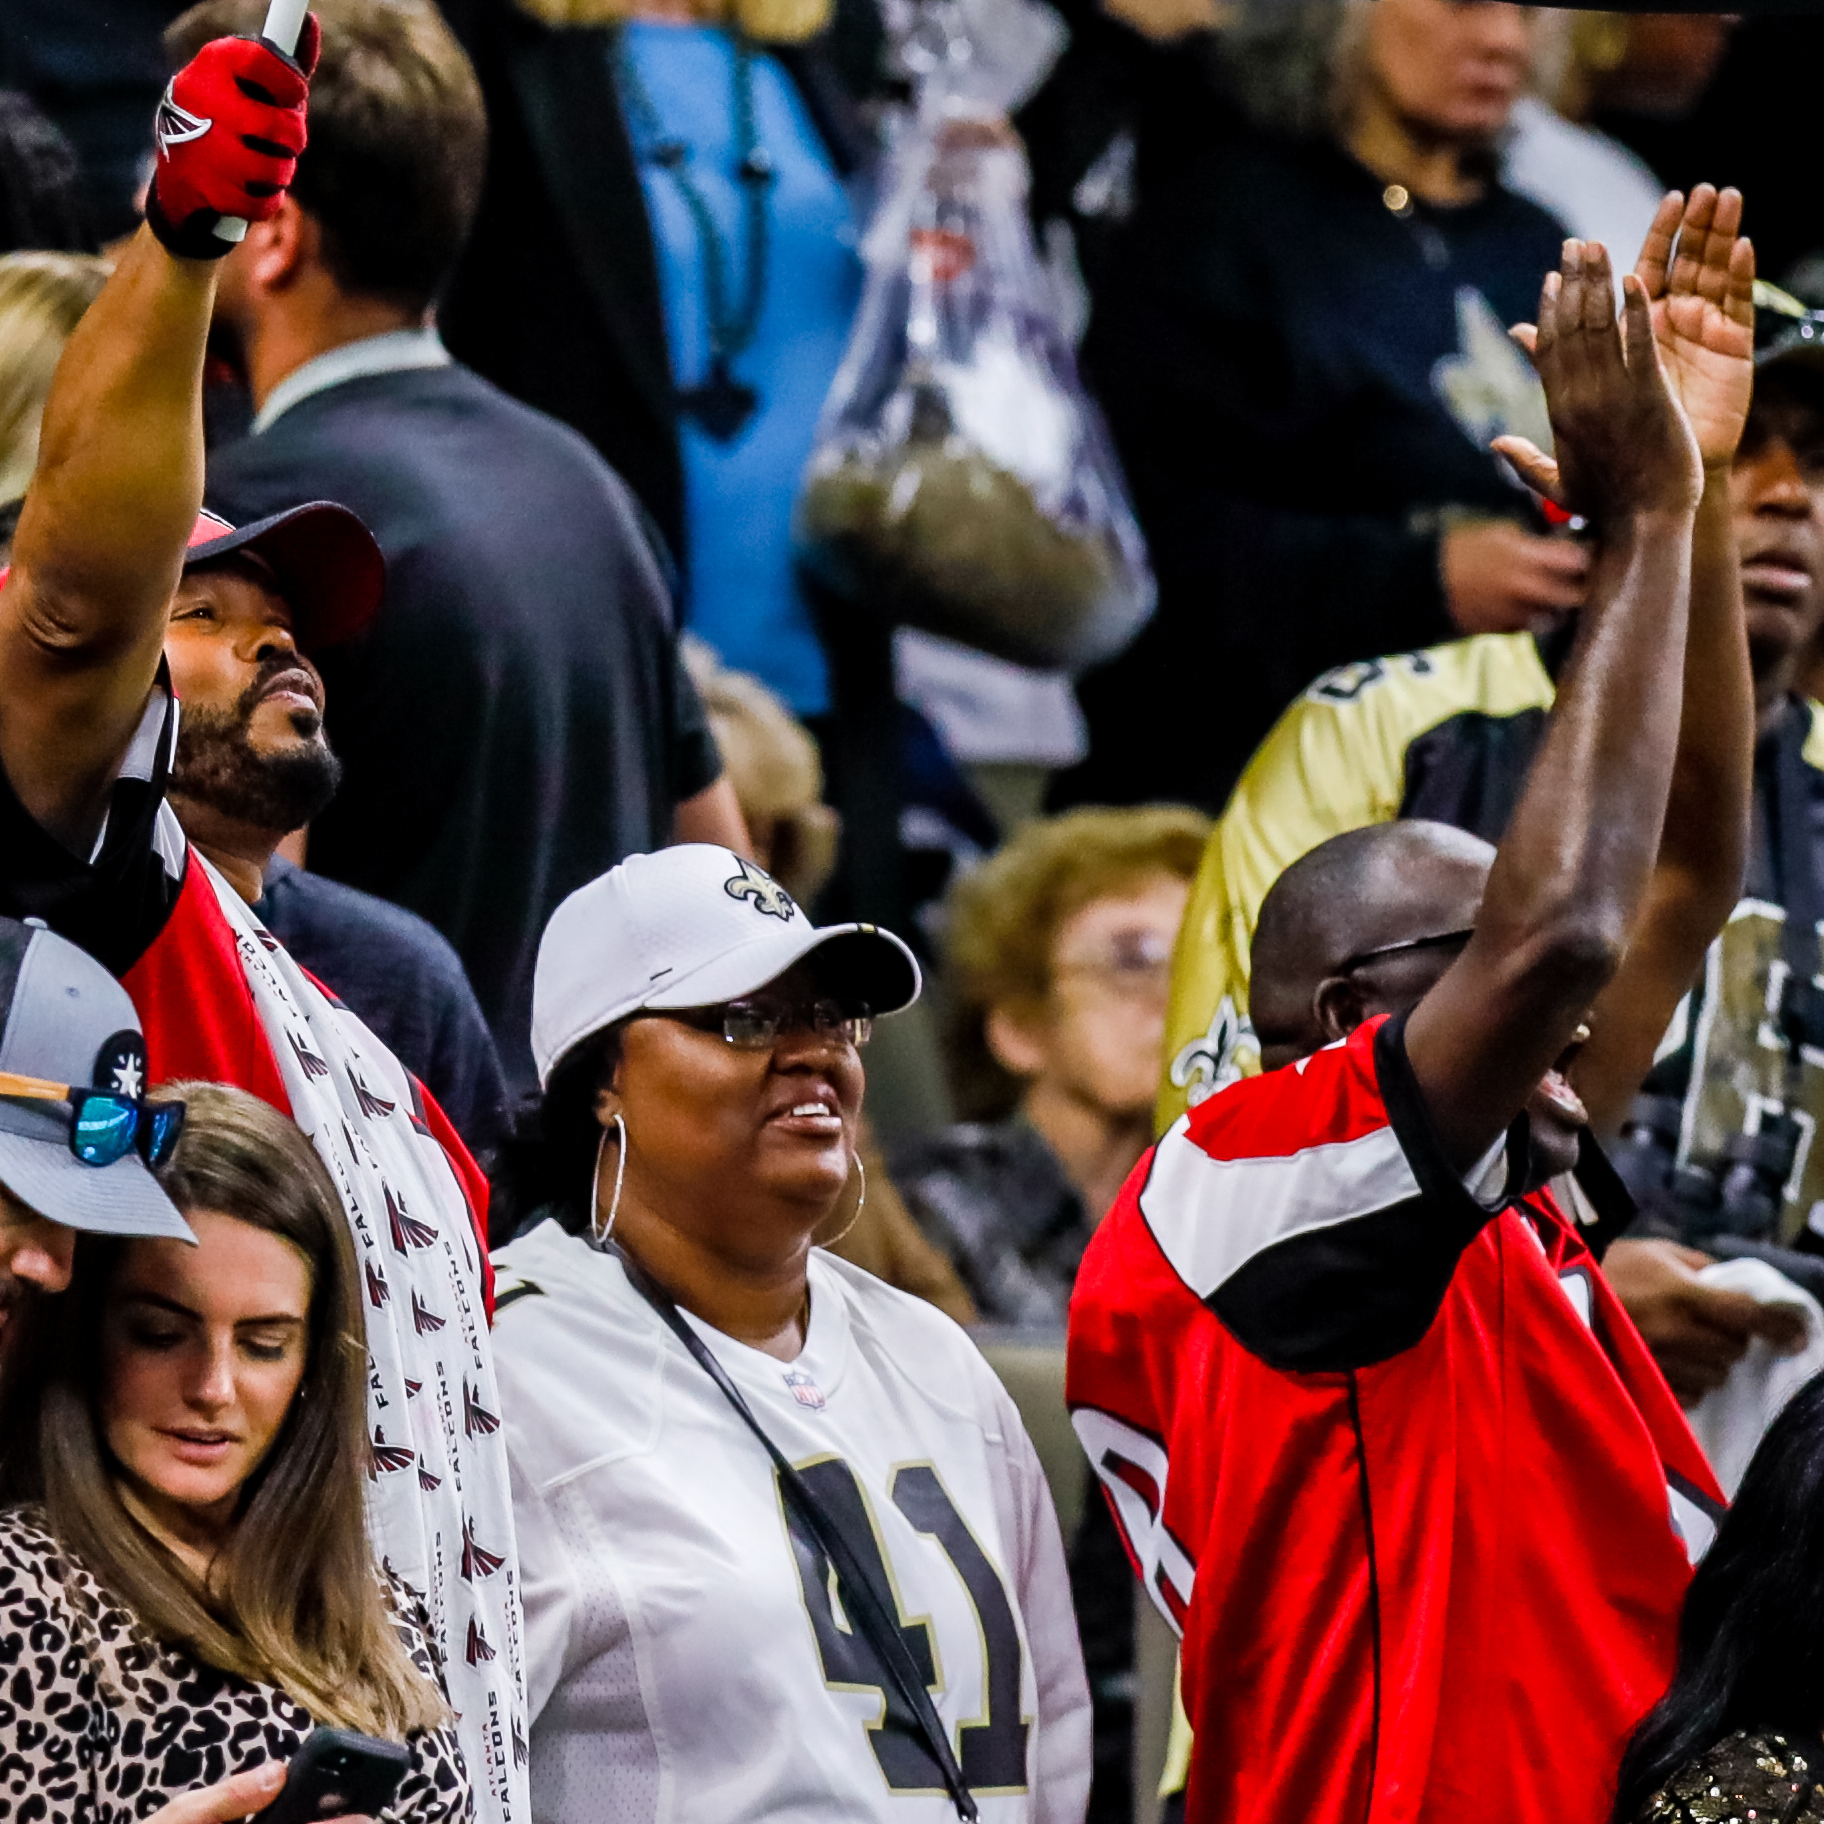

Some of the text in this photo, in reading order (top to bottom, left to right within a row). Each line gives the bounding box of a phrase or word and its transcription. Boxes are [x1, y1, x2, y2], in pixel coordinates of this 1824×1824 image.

[443, 1241, 482, 1370] FALCONS
[435, 1360, 462, 1492] FALCONS
[435, 1531, 448, 1662] FALCONS
[773, 1450, 1033, 1797] 41
[481, 1722, 497, 1797] ATLANTA
[487, 1691, 511, 1823] FALCONS
